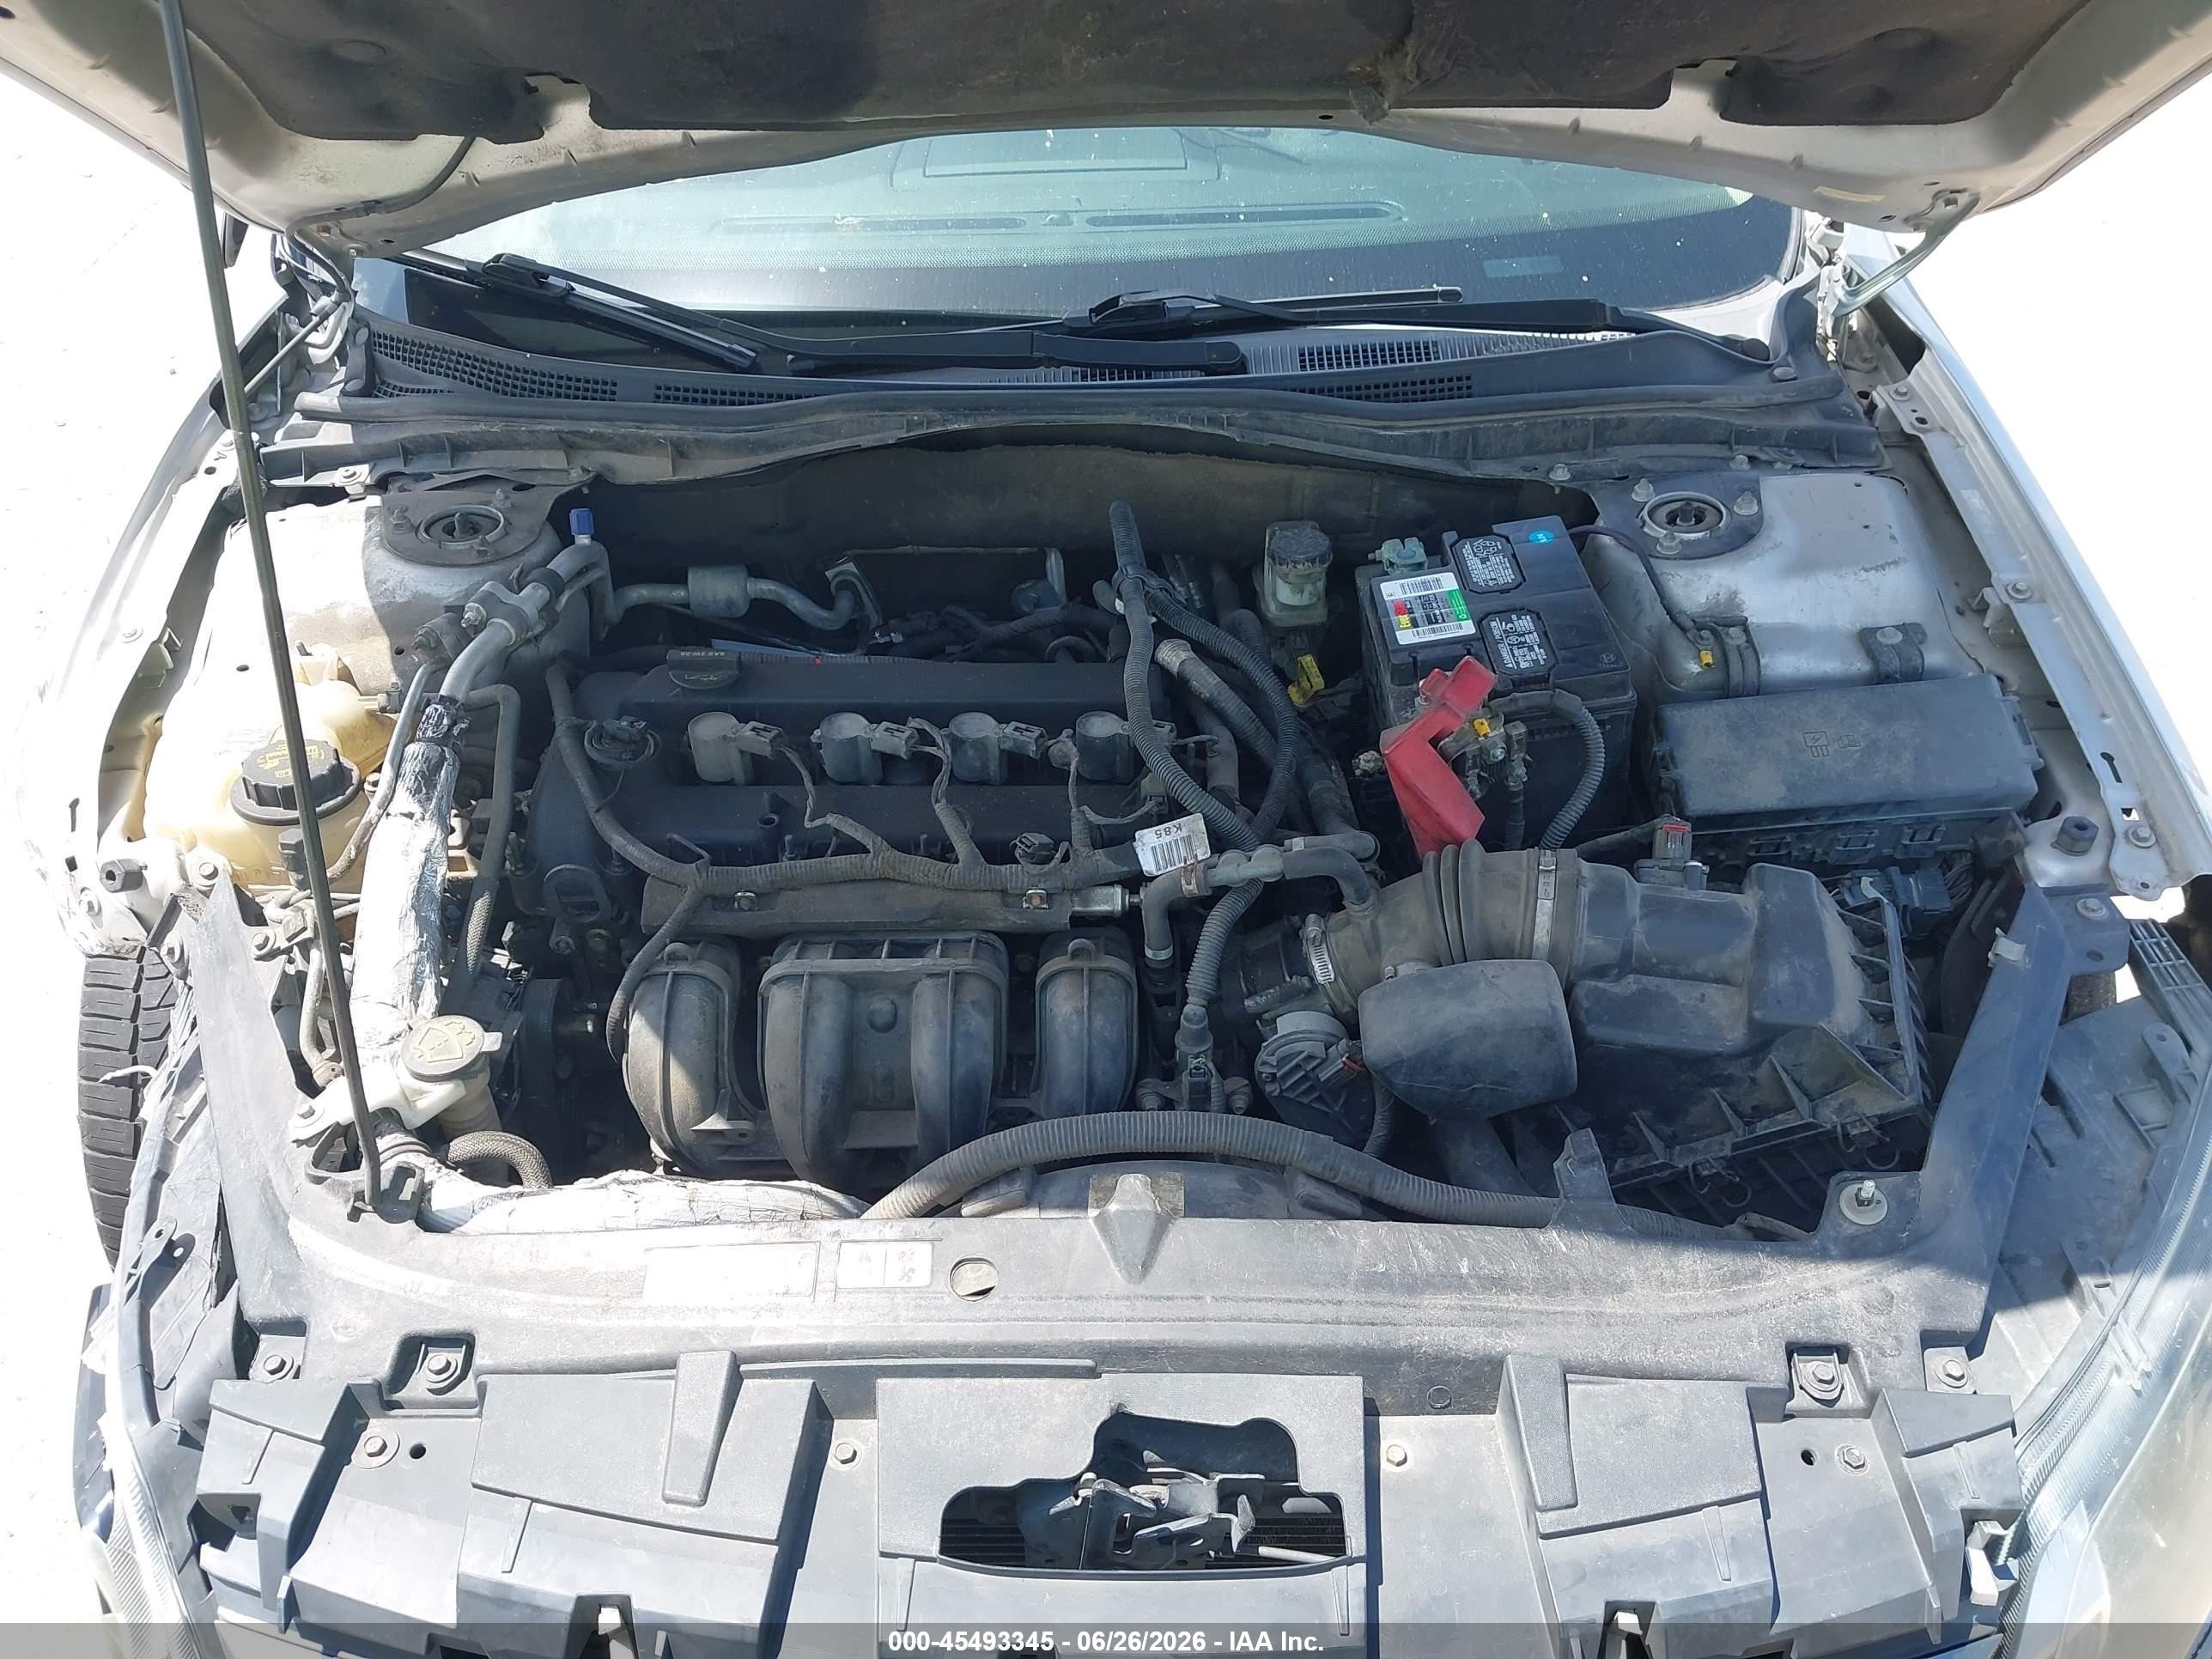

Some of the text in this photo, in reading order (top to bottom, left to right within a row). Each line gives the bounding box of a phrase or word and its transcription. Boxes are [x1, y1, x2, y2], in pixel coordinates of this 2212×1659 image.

[1489, 620, 1503, 640] POISON
[1498, 642, 1512, 664] DANGER
[1154, 823, 1182, 839] K85
